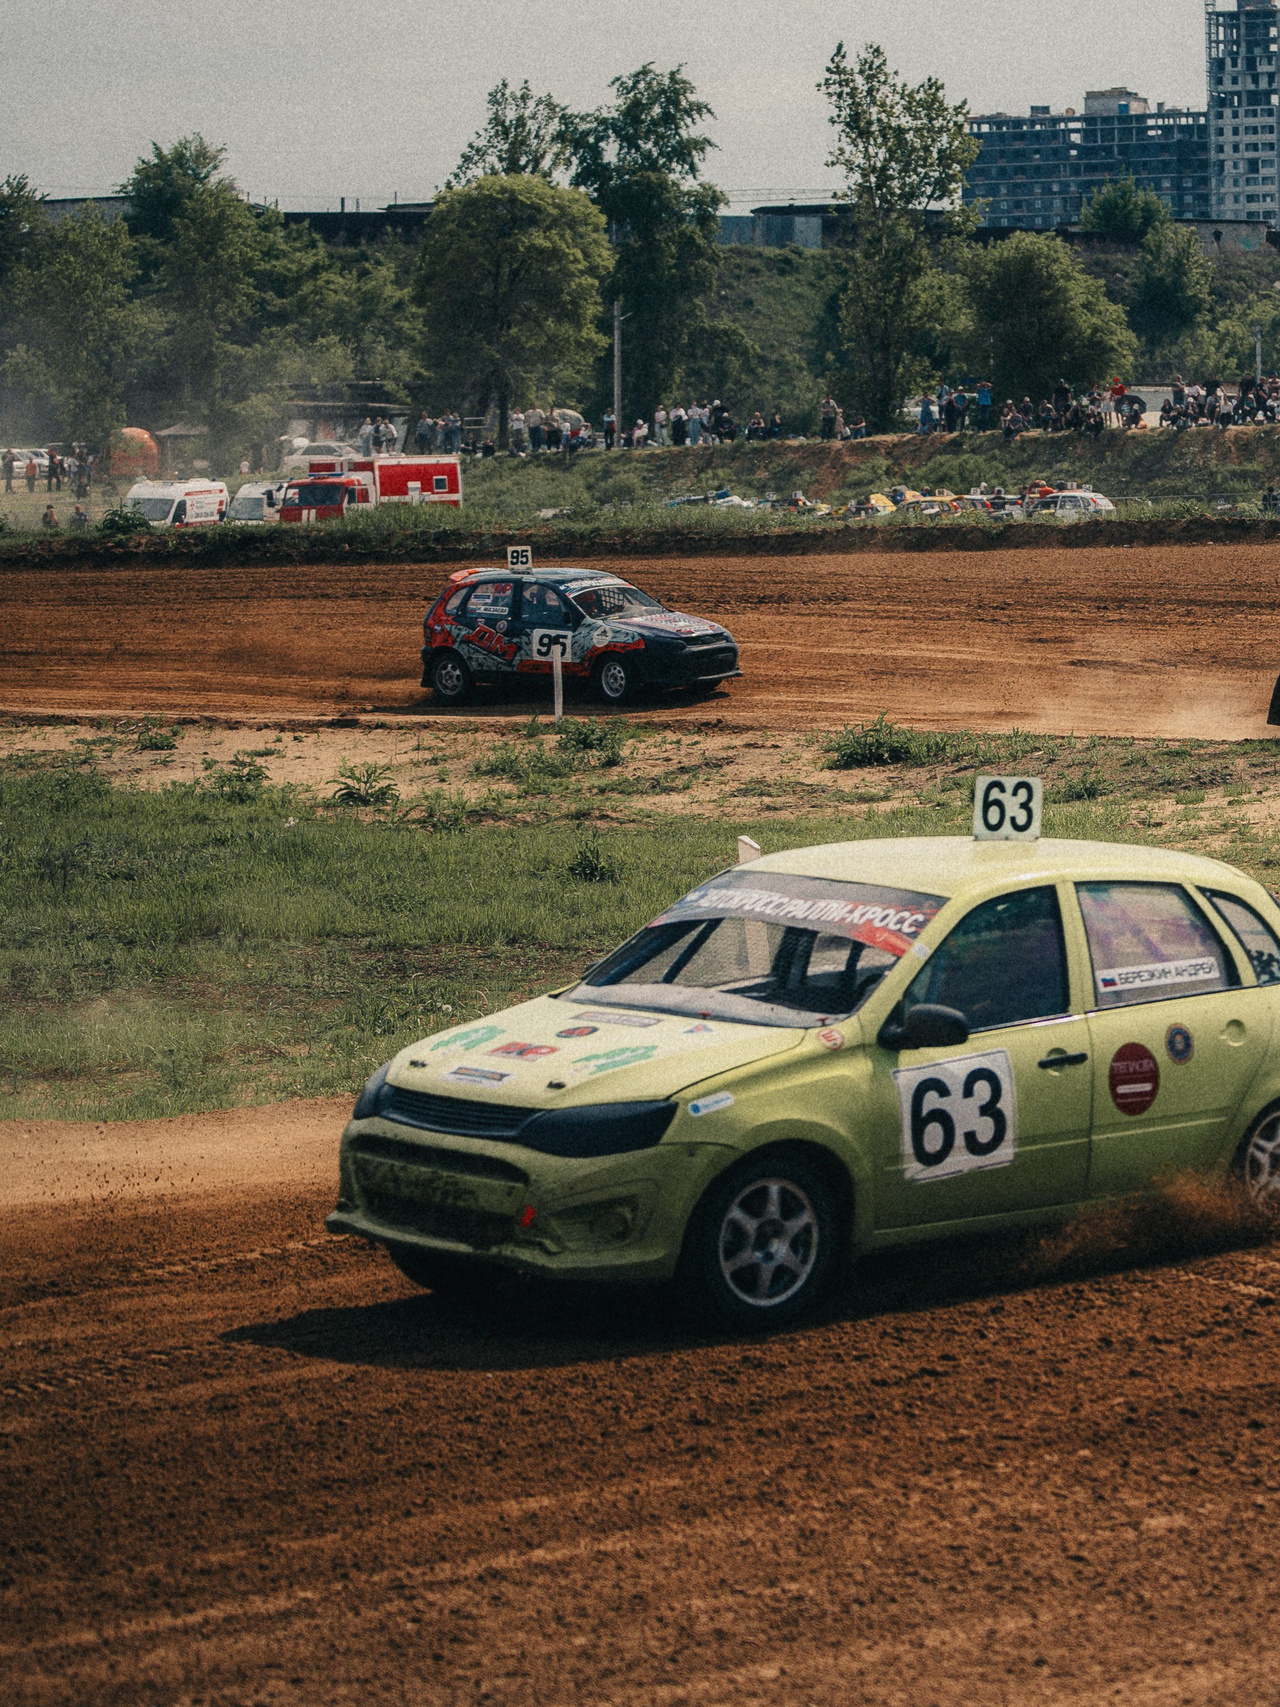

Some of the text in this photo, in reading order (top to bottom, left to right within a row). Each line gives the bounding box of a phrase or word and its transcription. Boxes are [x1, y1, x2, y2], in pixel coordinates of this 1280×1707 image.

[510, 549, 529, 565] 95
[982, 780, 1034, 832] 63
[911, 1067, 1006, 1167] 63
